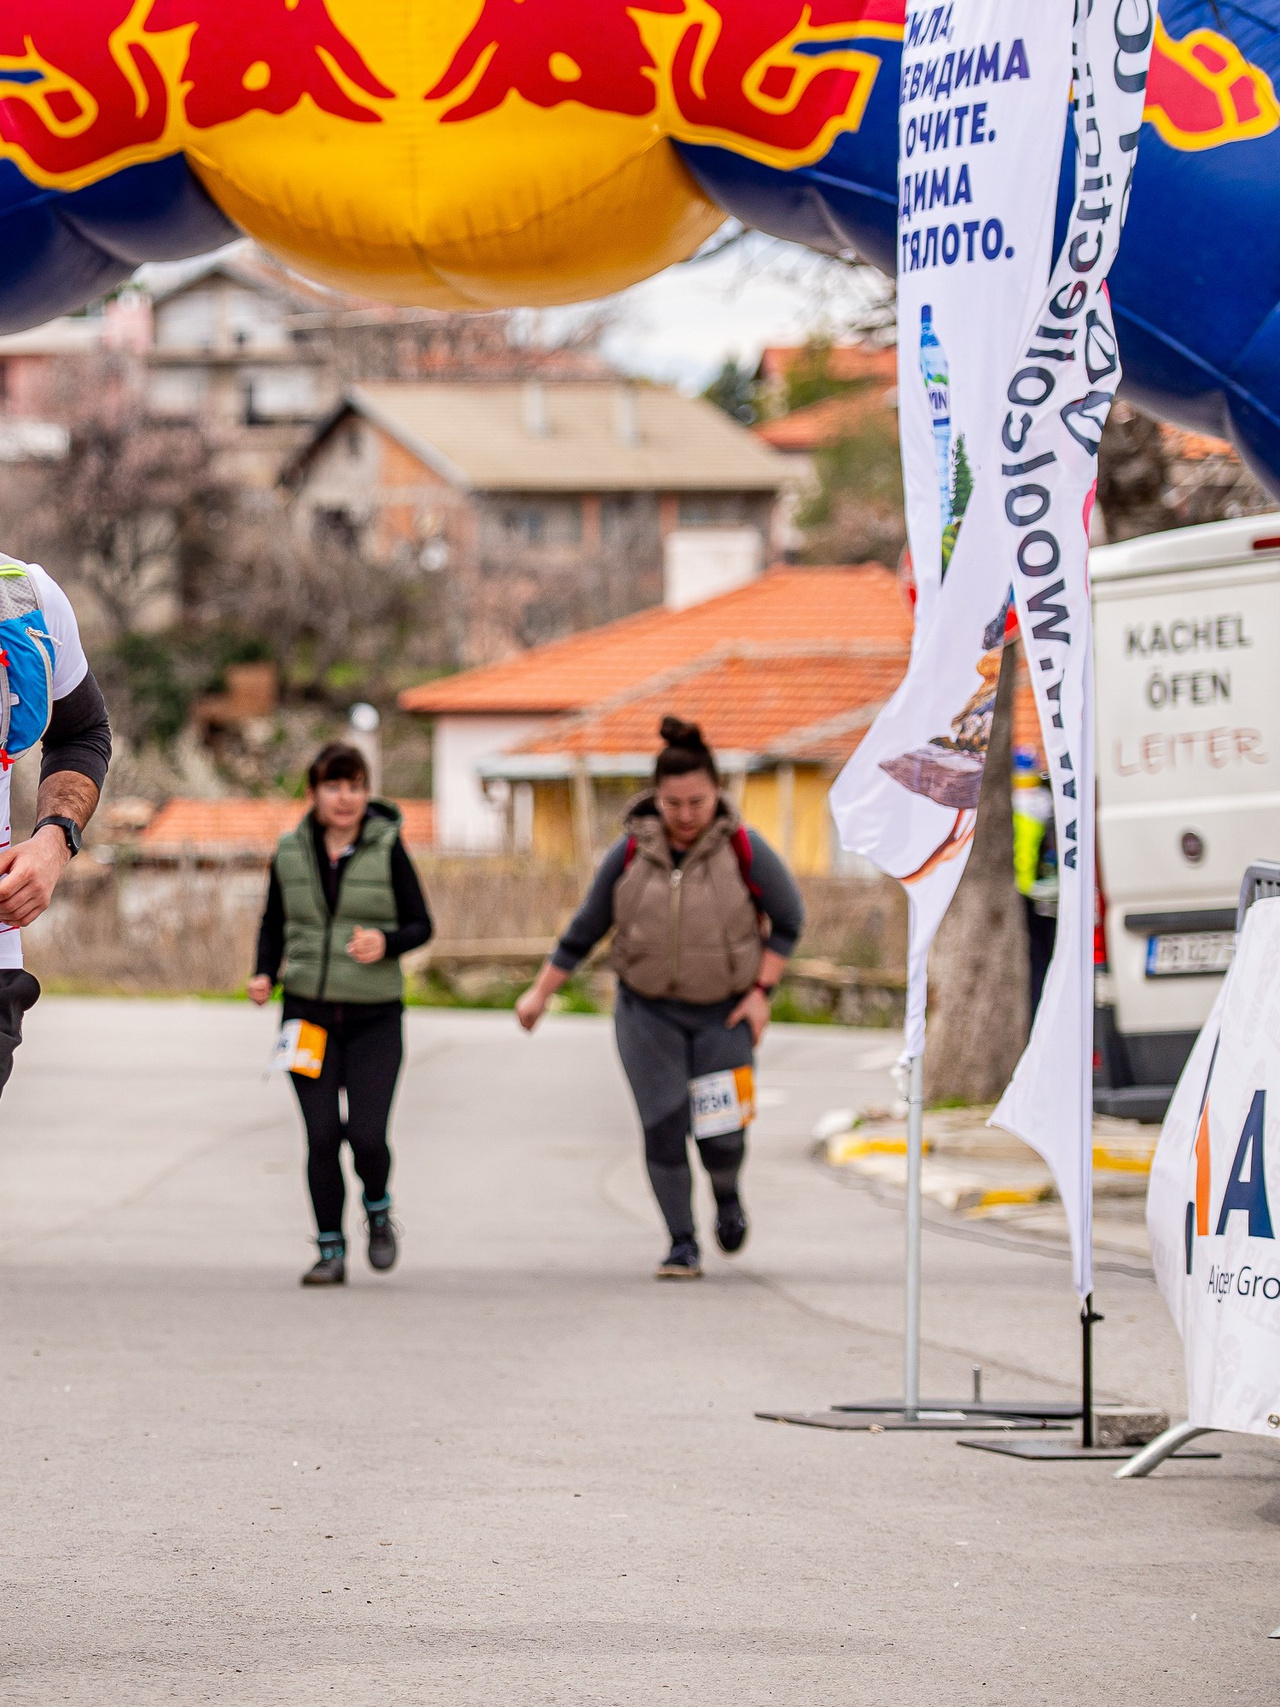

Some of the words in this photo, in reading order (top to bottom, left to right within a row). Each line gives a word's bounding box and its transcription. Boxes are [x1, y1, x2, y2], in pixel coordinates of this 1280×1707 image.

[906, 102, 996, 158] ОЧИТЕ.
[1124, 612, 1252, 659] KACHEL
[1112, 726, 1269, 776] LEITER
